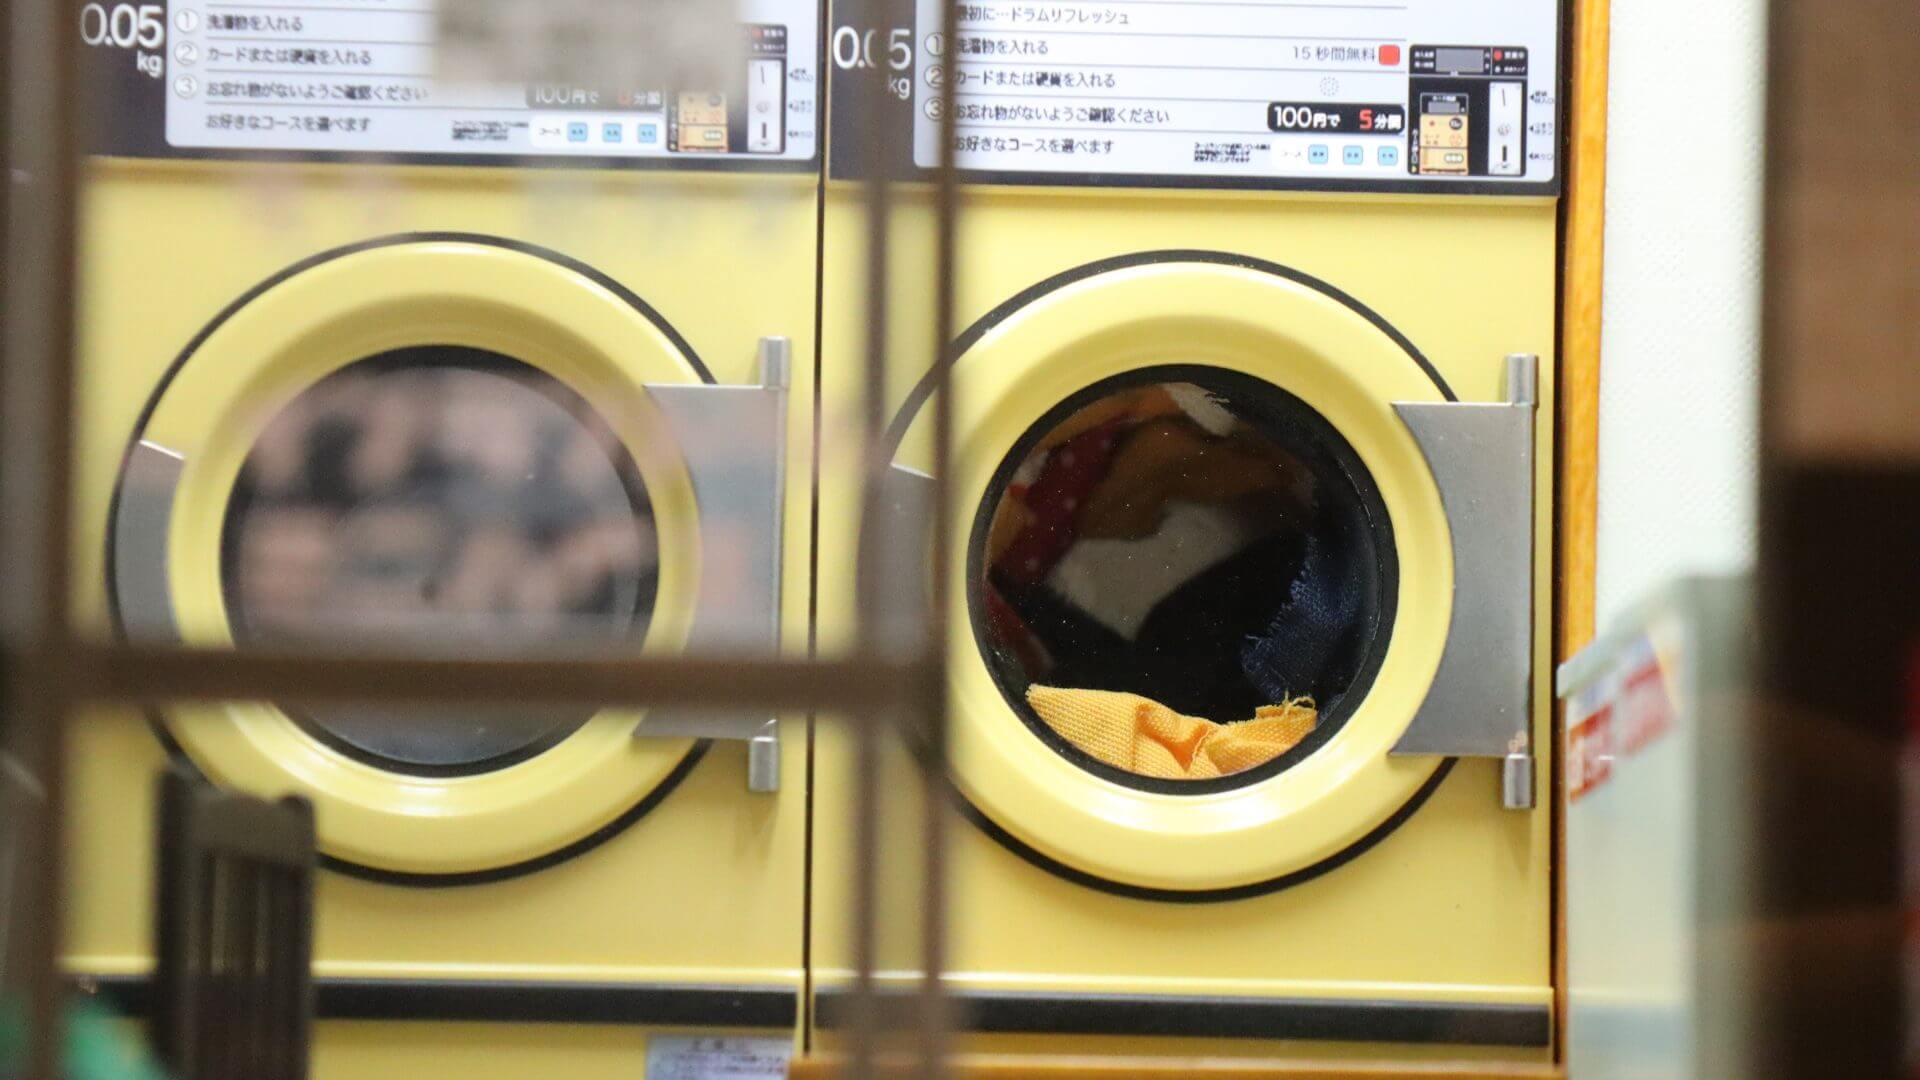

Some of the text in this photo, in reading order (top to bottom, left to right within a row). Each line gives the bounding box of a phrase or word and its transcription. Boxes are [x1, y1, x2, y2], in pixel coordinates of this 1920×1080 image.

[80, 3, 164, 48] 0.05
[136, 52, 163, 78] kg
[1293, 45, 1376, 62] 15 秒間無料
[888, 75, 911, 98] kg
[1274, 105, 1341, 128] 100円で
